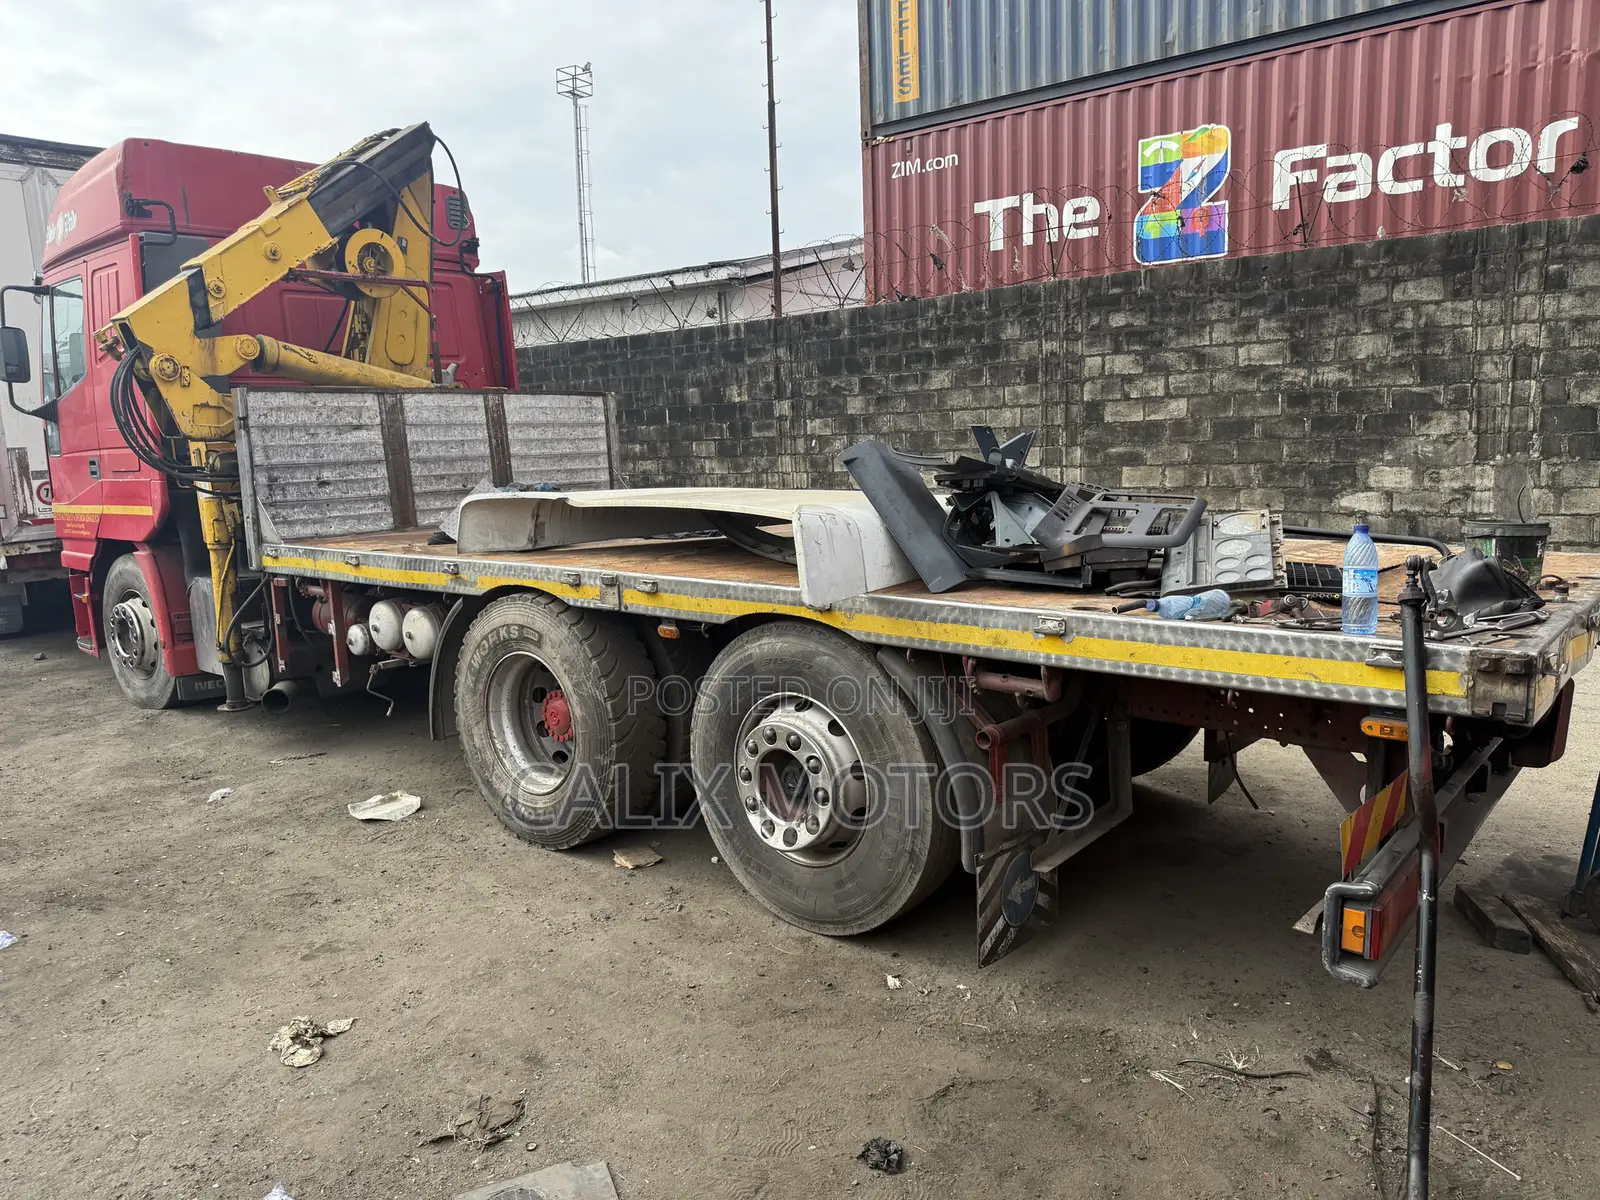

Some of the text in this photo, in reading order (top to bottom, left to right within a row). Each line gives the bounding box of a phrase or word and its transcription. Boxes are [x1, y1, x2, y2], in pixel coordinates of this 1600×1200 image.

[891, 153, 959, 180] ZIM.com
[974, 192, 1101, 252] The
[1272, 116, 1580, 211] Factor
[194, 679, 227, 692] IVEC
